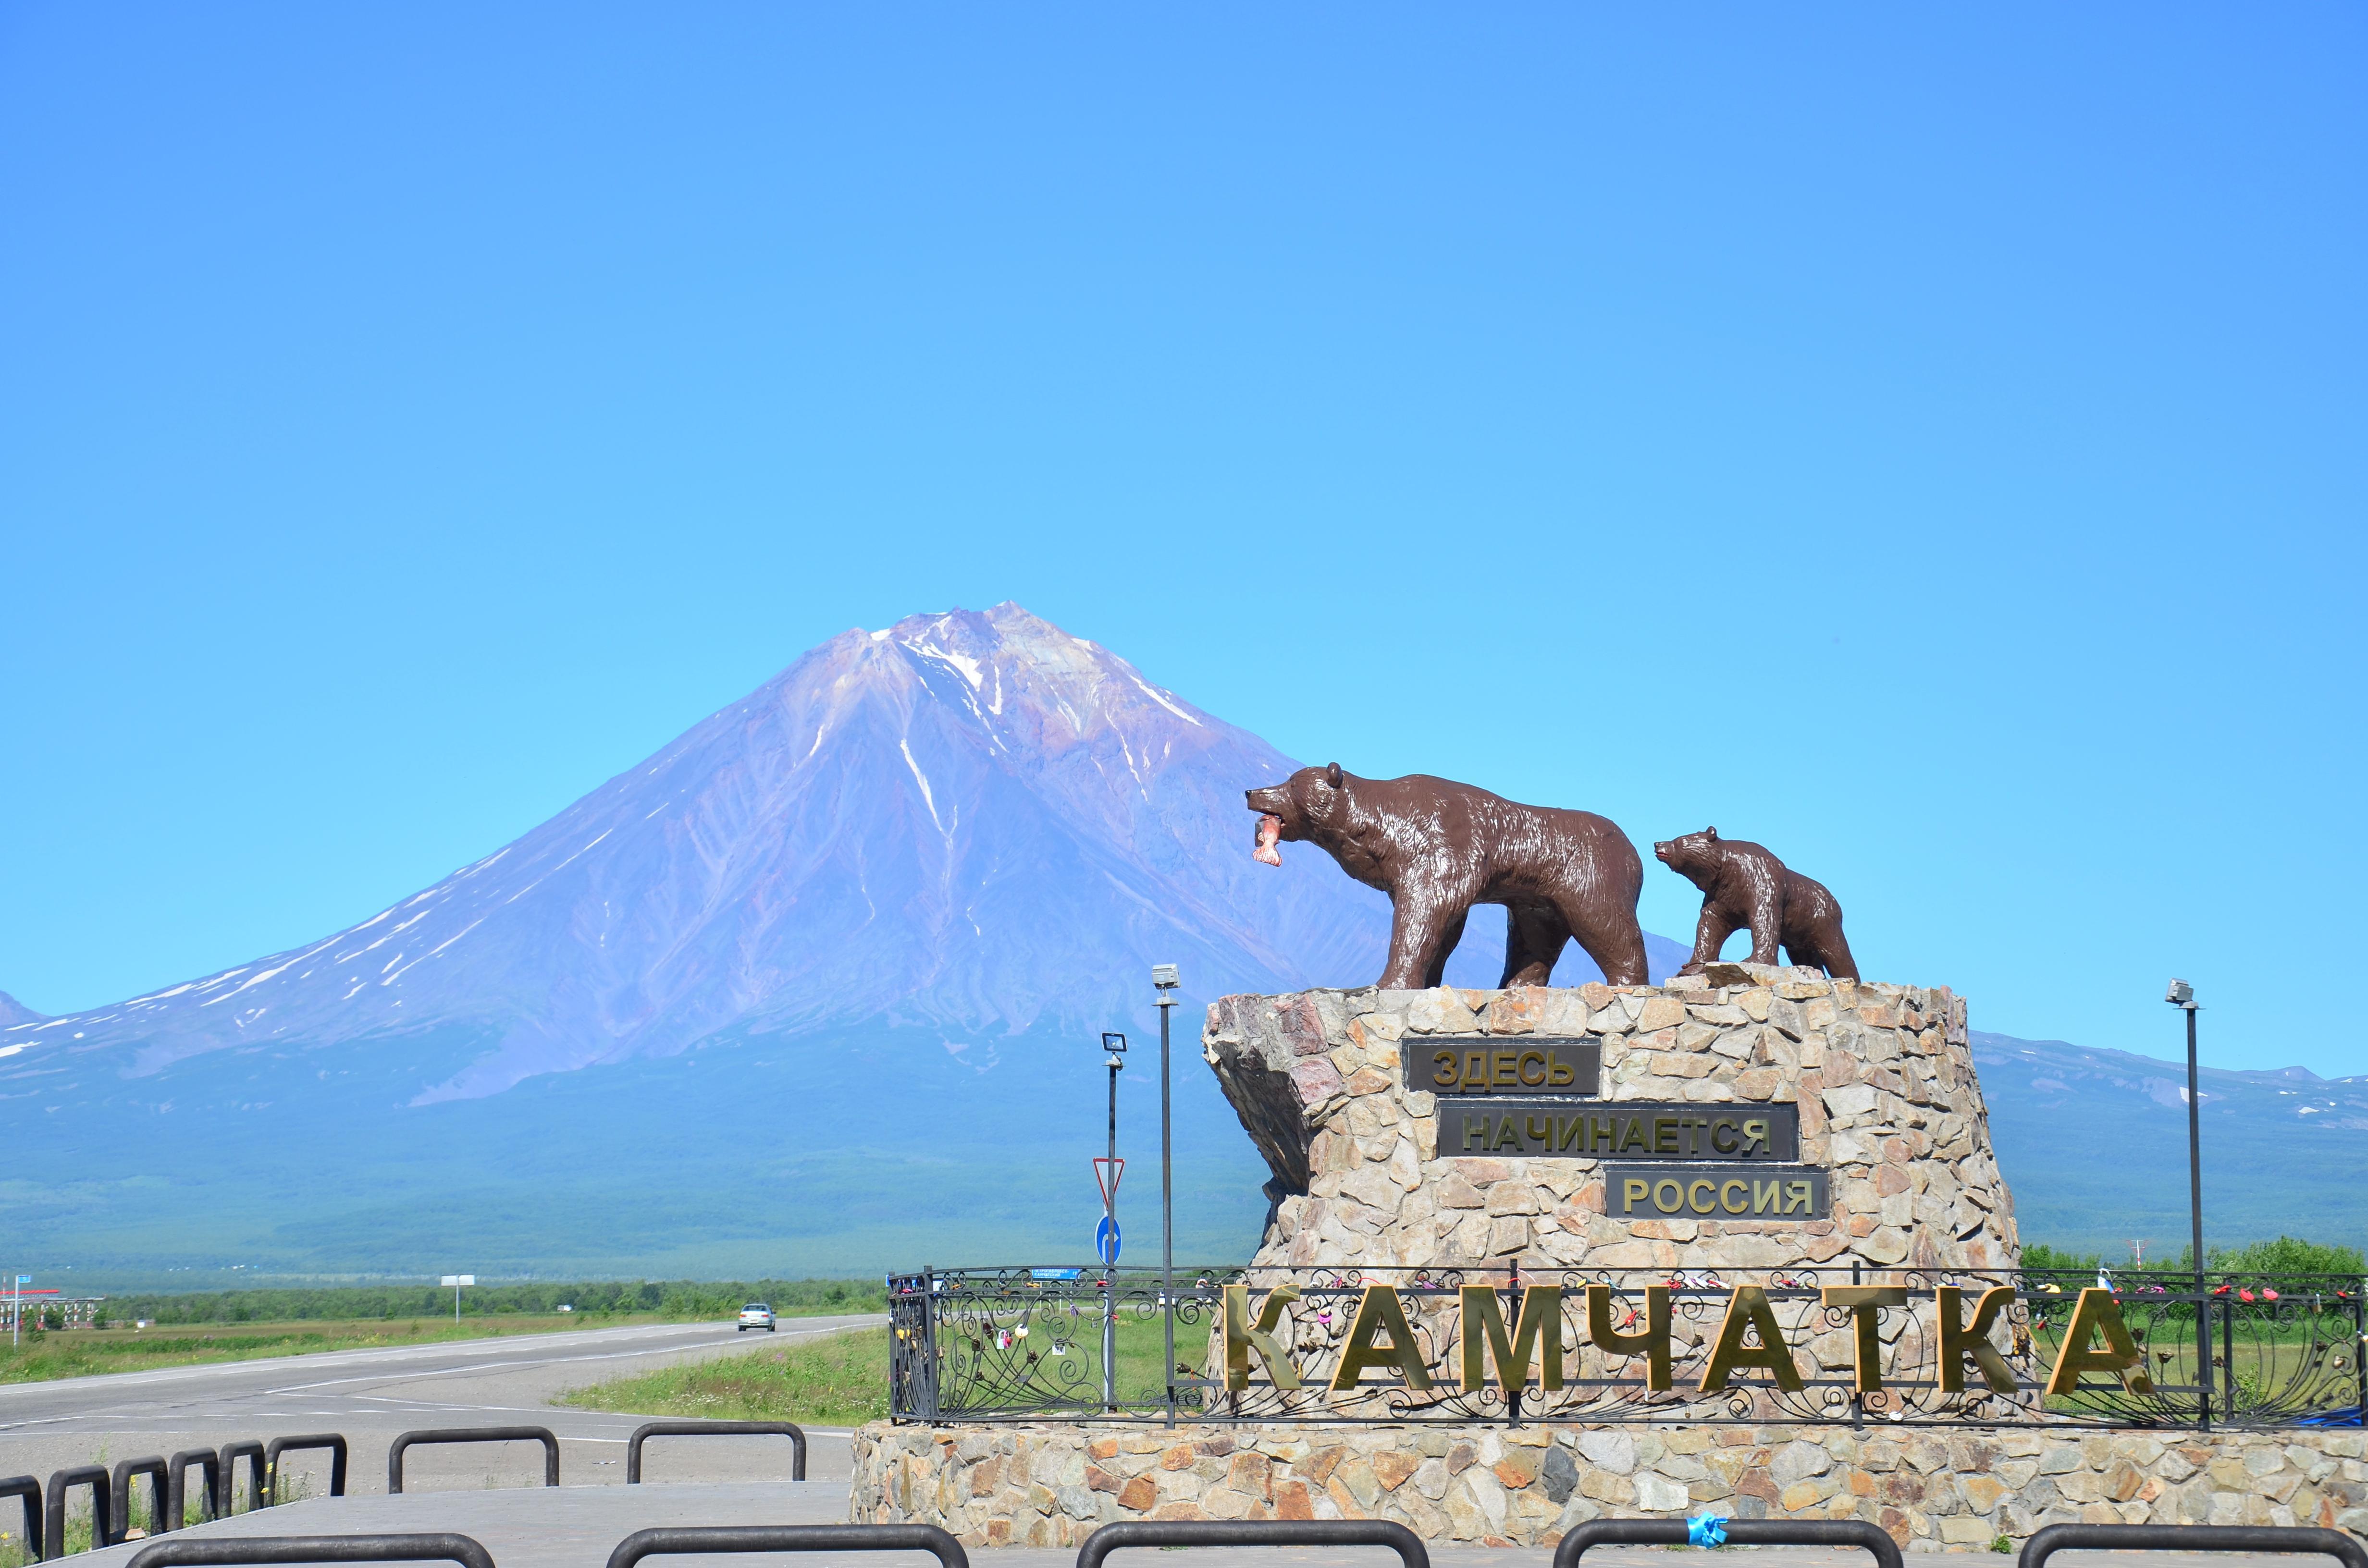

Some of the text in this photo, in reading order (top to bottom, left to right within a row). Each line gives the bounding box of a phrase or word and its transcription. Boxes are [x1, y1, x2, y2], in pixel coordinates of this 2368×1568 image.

[1432, 1050, 1575, 1092] ЗДЕСЬ
[1463, 1114, 1770, 1154] НАЧИНАЕТСЯ
[1624, 1178, 1813, 1215] РОССИЯ
[1223, 1283, 2155, 1396] КАМЧАТКА
